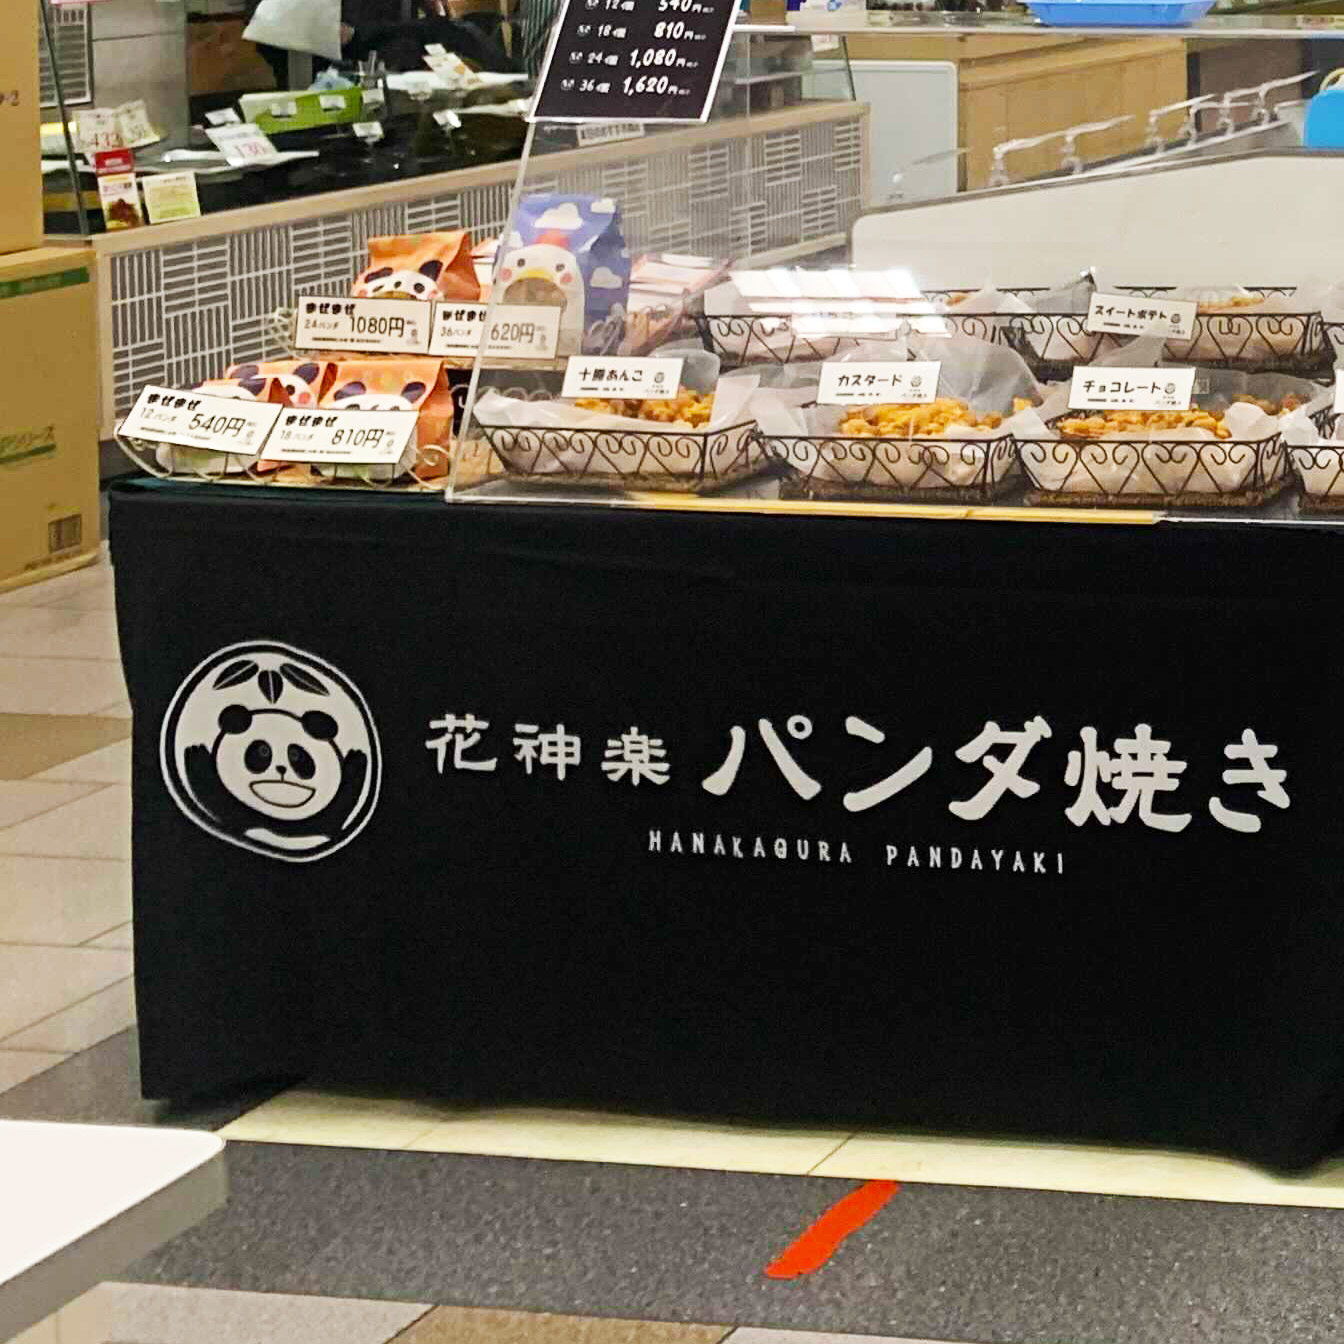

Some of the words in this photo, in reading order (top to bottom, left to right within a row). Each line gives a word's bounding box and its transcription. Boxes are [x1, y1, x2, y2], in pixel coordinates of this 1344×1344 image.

[837, 373, 904, 388] カスタード
[1082, 379, 1162, 395] チョコレート
[188, 411, 247, 438] 540円
[330, 427, 385, 449] 810円
[425, 712, 673, 788] 花神楽
[701, 715, 1293, 835] パンダ焼き
[647, 829, 856, 865] HANAKAGURA
[886, 843, 1067, 876] PANDAYAKI
